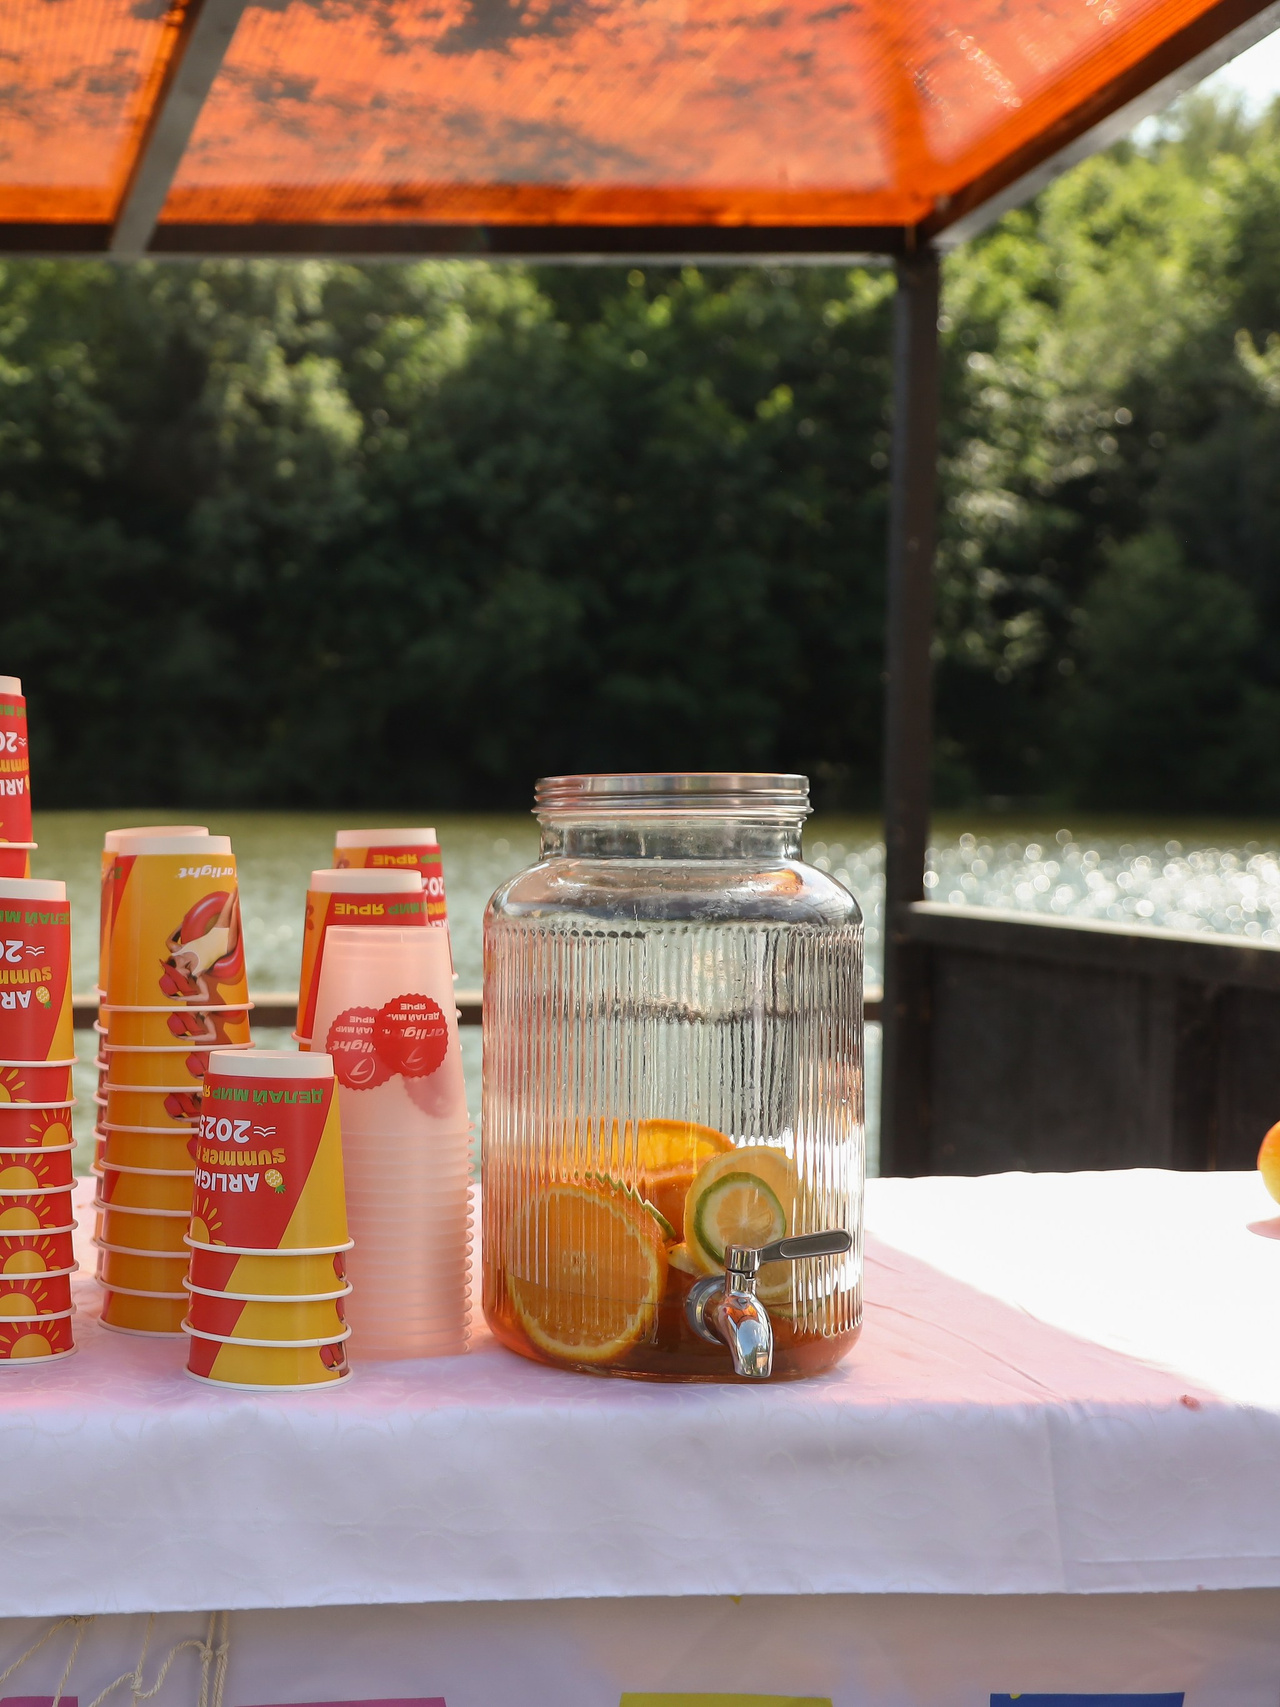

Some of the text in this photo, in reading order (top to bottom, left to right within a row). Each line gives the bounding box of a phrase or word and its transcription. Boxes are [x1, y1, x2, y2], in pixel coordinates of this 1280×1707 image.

[372, 854, 418, 865] ЯРЧЕ
[178, 865, 234, 878] arlight
[334, 902, 385, 915] ЯРЧЕ
[25, 911, 70, 927] ЕЛАЙ
[349, 1016, 375, 1024] ЯРЧЕ
[408, 1012, 440, 1022] ДЕЛАЙ
[335, 1026, 357, 1034] МИР
[212, 1087, 249, 1101] МИР
[253, 1088, 324, 1106] ДЕЛАЙ
[200, 1114, 251, 1144] 2025
[195, 1167, 260, 1193] ARLIGH
